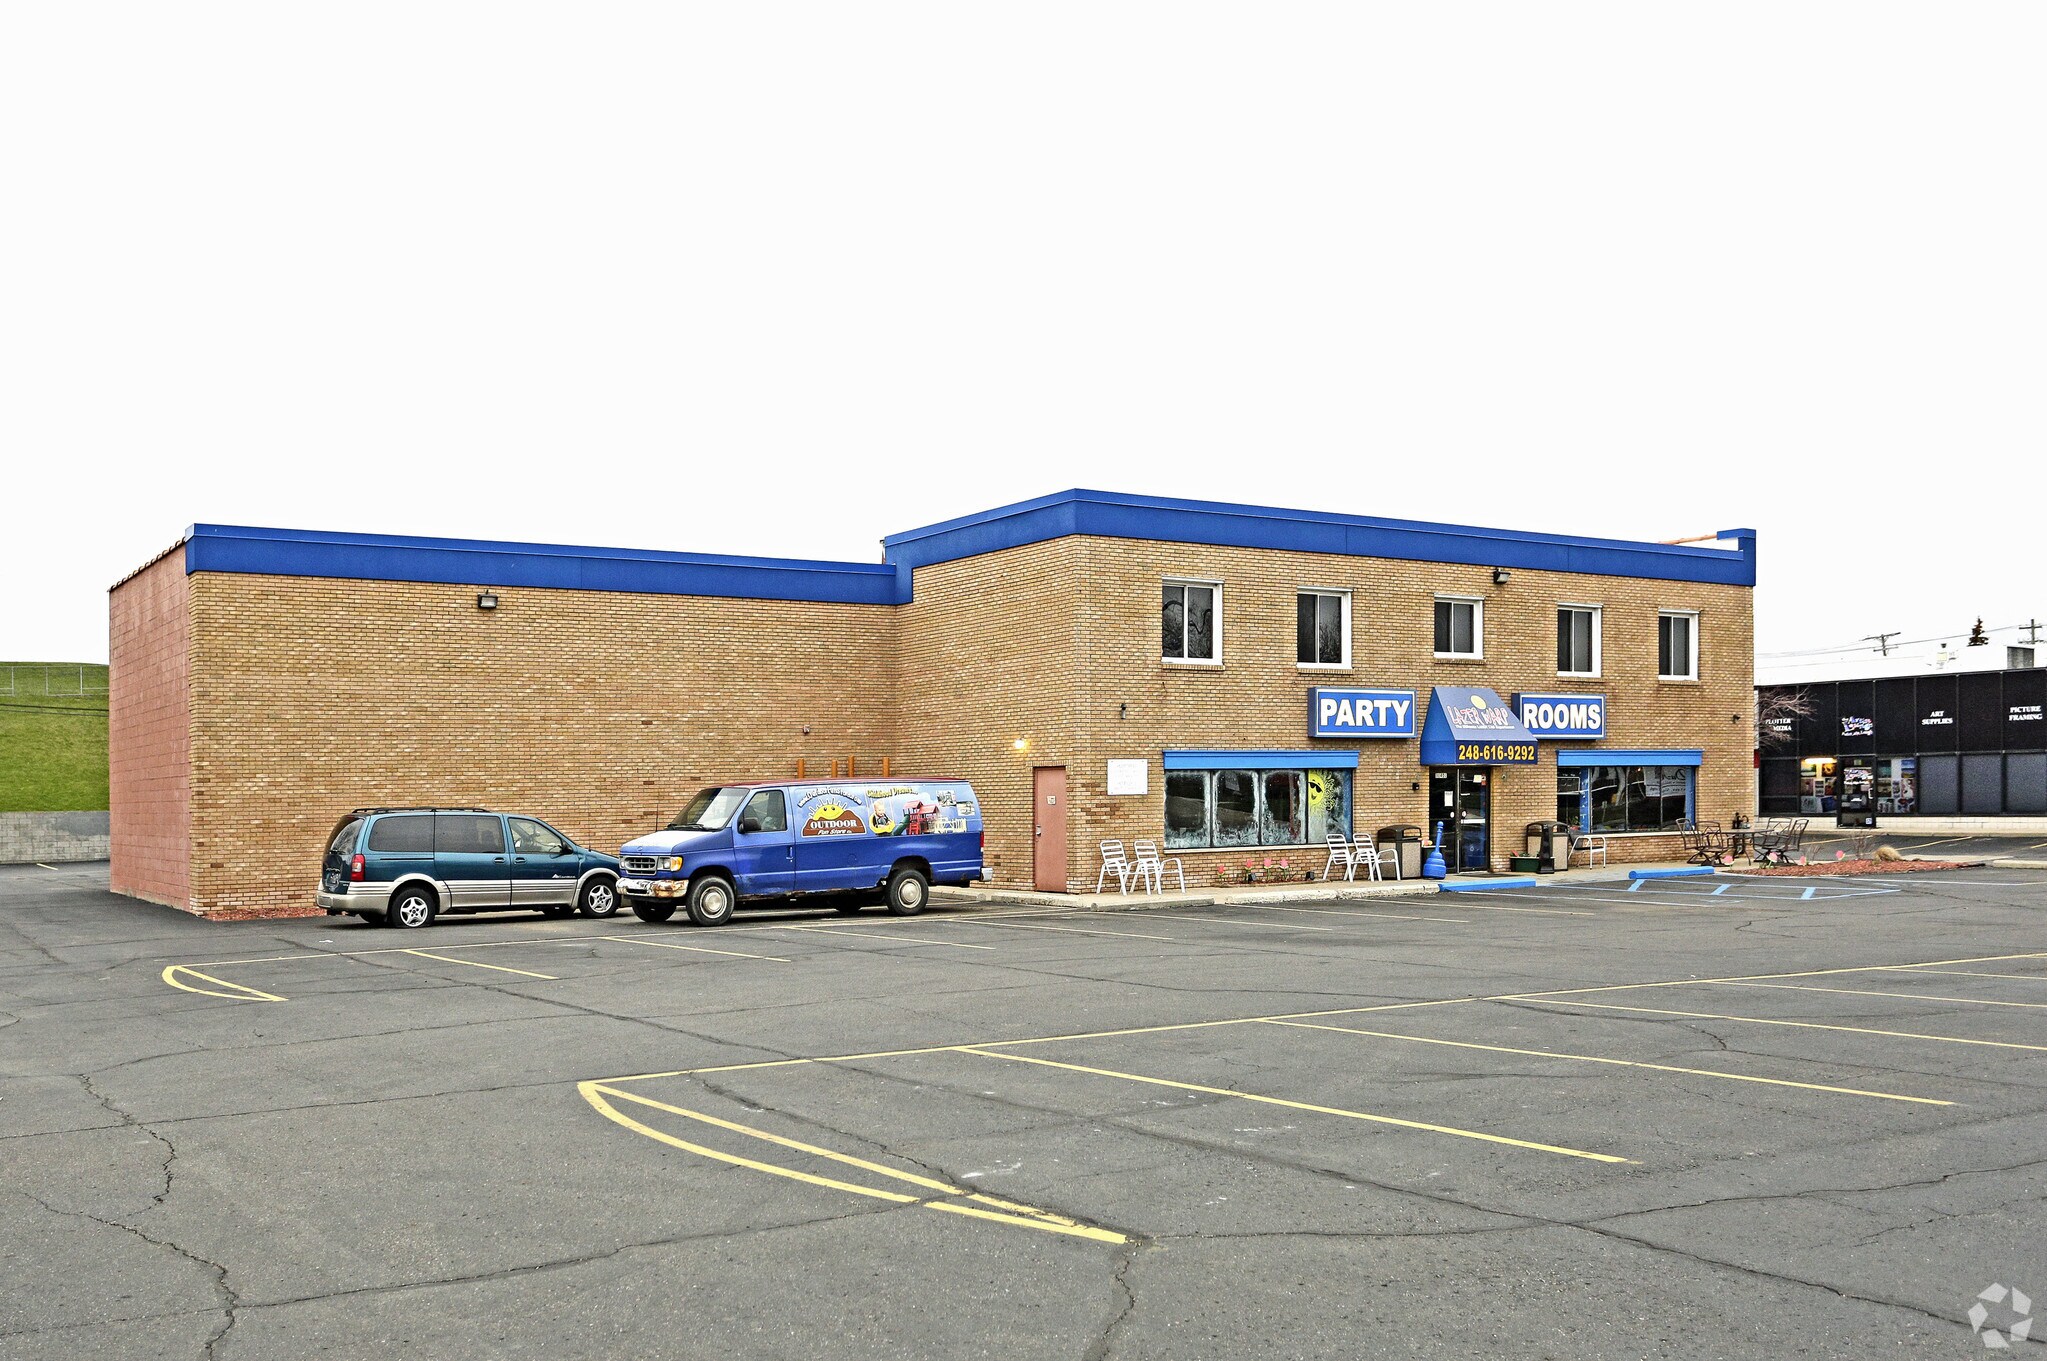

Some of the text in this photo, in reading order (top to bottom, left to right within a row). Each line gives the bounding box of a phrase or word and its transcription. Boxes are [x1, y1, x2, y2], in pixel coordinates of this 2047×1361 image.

[1320, 698, 1411, 727] PARTY
[1929, 710, 1945, 718] ART
[2009, 705, 2042, 713] PICTURE
[1446, 705, 1485, 726] LAZER
[1522, 703, 1602, 730] ROOMS
[2008, 713, 2043, 721] FRAMING
[1921, 717, 1954, 726] SUPPLIES
[1458, 745, 1535, 761] 248-616-9292
[810, 819, 858, 829] OUTDOOR
